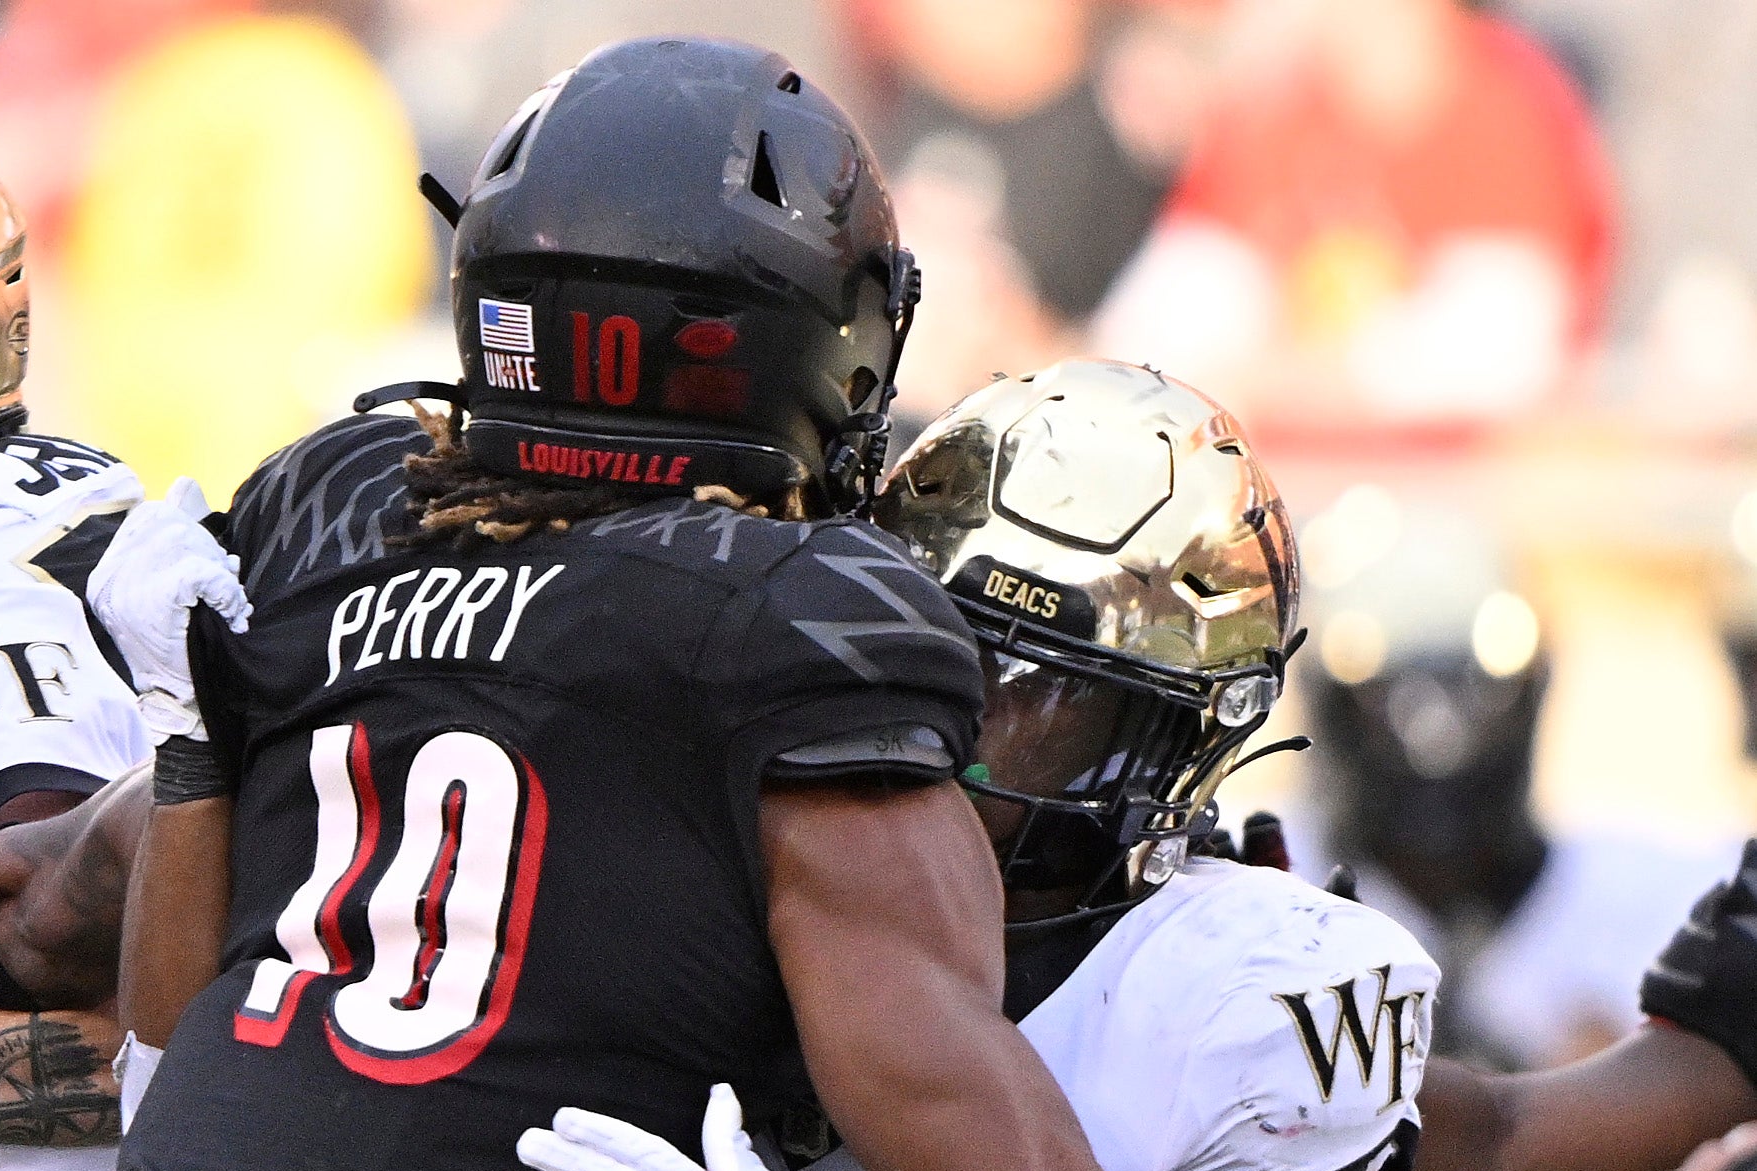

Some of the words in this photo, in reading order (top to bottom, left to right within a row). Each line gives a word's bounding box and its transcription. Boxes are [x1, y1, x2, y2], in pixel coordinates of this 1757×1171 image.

[484, 351, 542, 392] UNITE
[570, 310, 640, 406] 10
[518, 441, 691, 485] LOUISVILLE
[324, 563, 566, 688] PERRY
[983, 569, 1061, 619] DEACS
[232, 719, 549, 1086] 10
[1270, 962, 1426, 1117] WF
